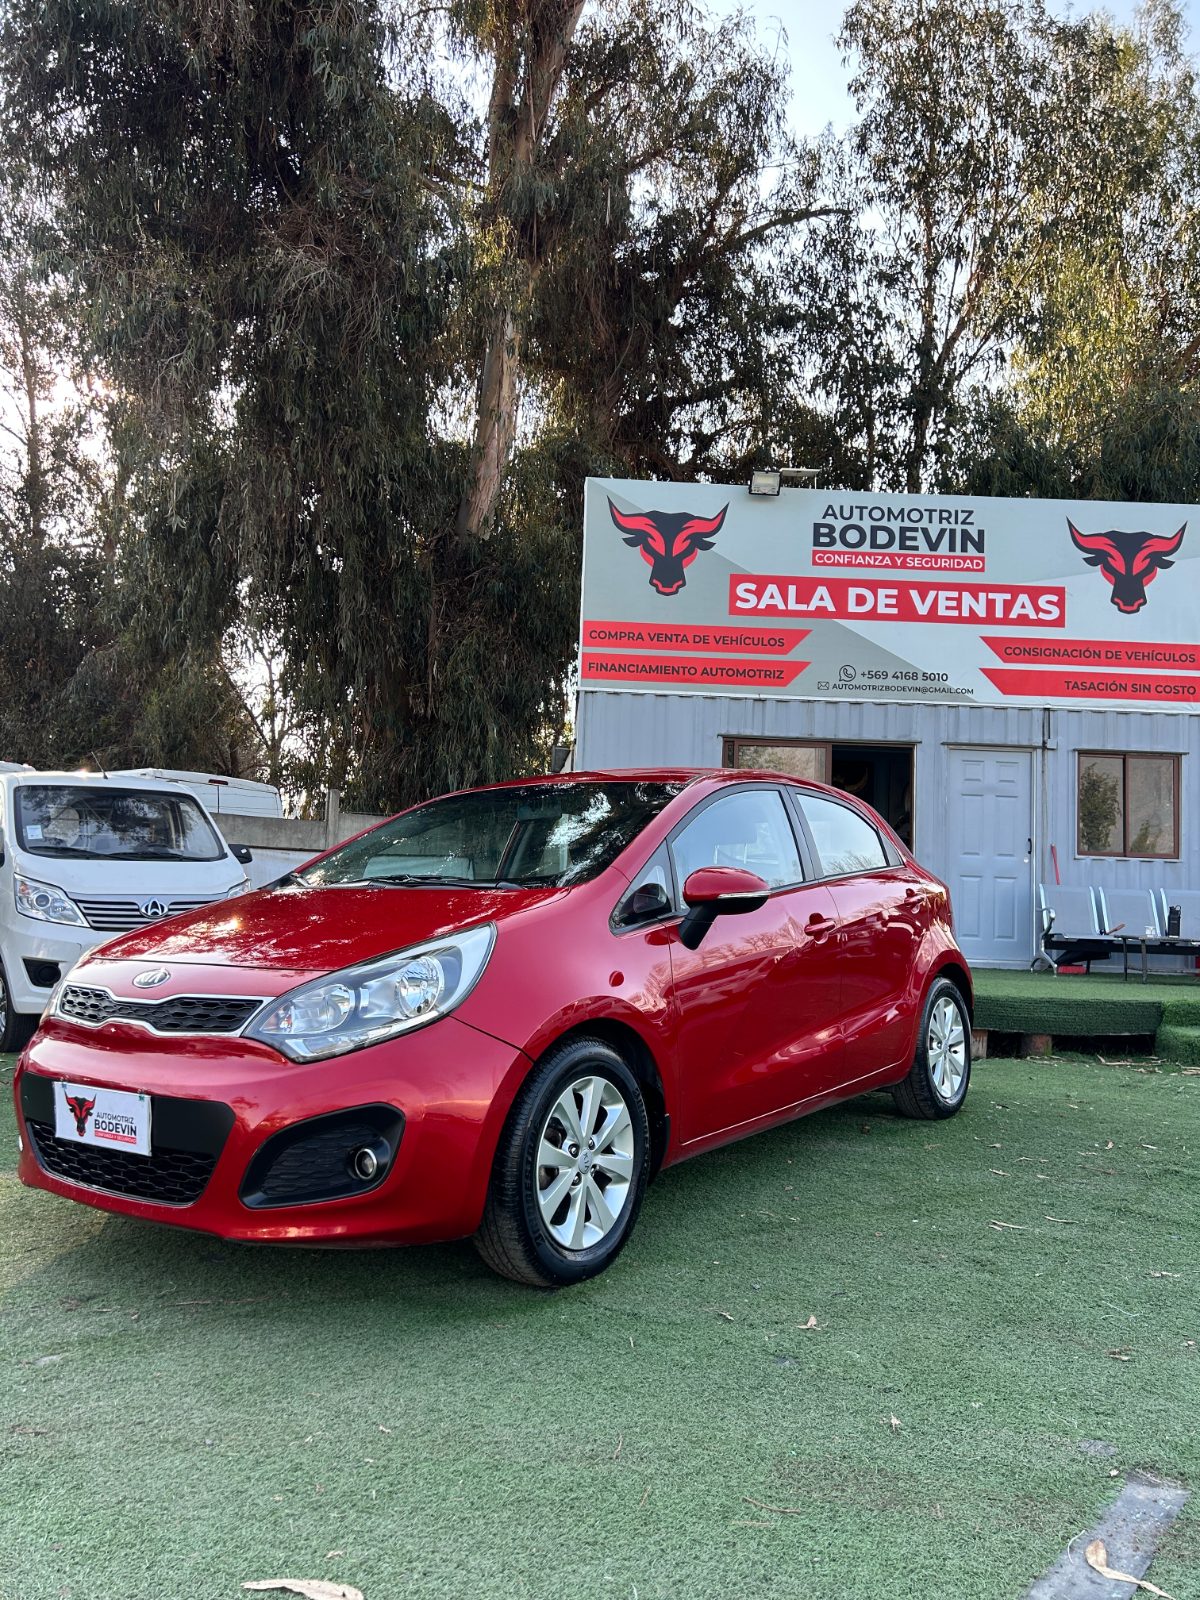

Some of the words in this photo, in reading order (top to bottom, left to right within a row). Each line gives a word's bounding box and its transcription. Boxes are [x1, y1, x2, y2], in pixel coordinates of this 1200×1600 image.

[822, 504, 974, 526] AUTOMOTRIZ
[812, 522, 985, 553] BODEVIN
[815, 553, 892, 566] CONFIANZA
[894, 556, 904, 567] Y
[906, 556, 983, 570] SEGURIDAD
[735, 583, 836, 612] SALA
[847, 587, 899, 614] DE
[909, 589, 1061, 620] VENTAS
[589, 630, 645, 641] COMPRA
[648, 632, 689, 644] VENTA
[693, 634, 710, 645] DE
[713, 634, 785, 647] VEHÍCULOS
[1003, 646, 1102, 660] CONSIGNACIÓN
[1105, 650, 1122, 660] DE
[1125, 649, 1196, 663] VEHÍCULOS
[588, 662, 698, 676] FINANCIAMIENTO
[701, 667, 785, 680] AUTOMOTRIZ
[860, 670, 889, 680] +569
[891, 671, 919, 681] 4168
[921, 672, 949, 682] 5010
[832, 683, 974, 695] AUTOMOTRIZBODEVIN@GMAIL.COM
[1064, 680, 1128, 692] TASACIÓN
[1131, 683, 1151, 693] SIN
[1154, 684, 1197, 695] COSTO
[96, 1112, 135, 1125] AUTOMOTRIZ
[94, 1119, 137, 1136] BODEVIN
